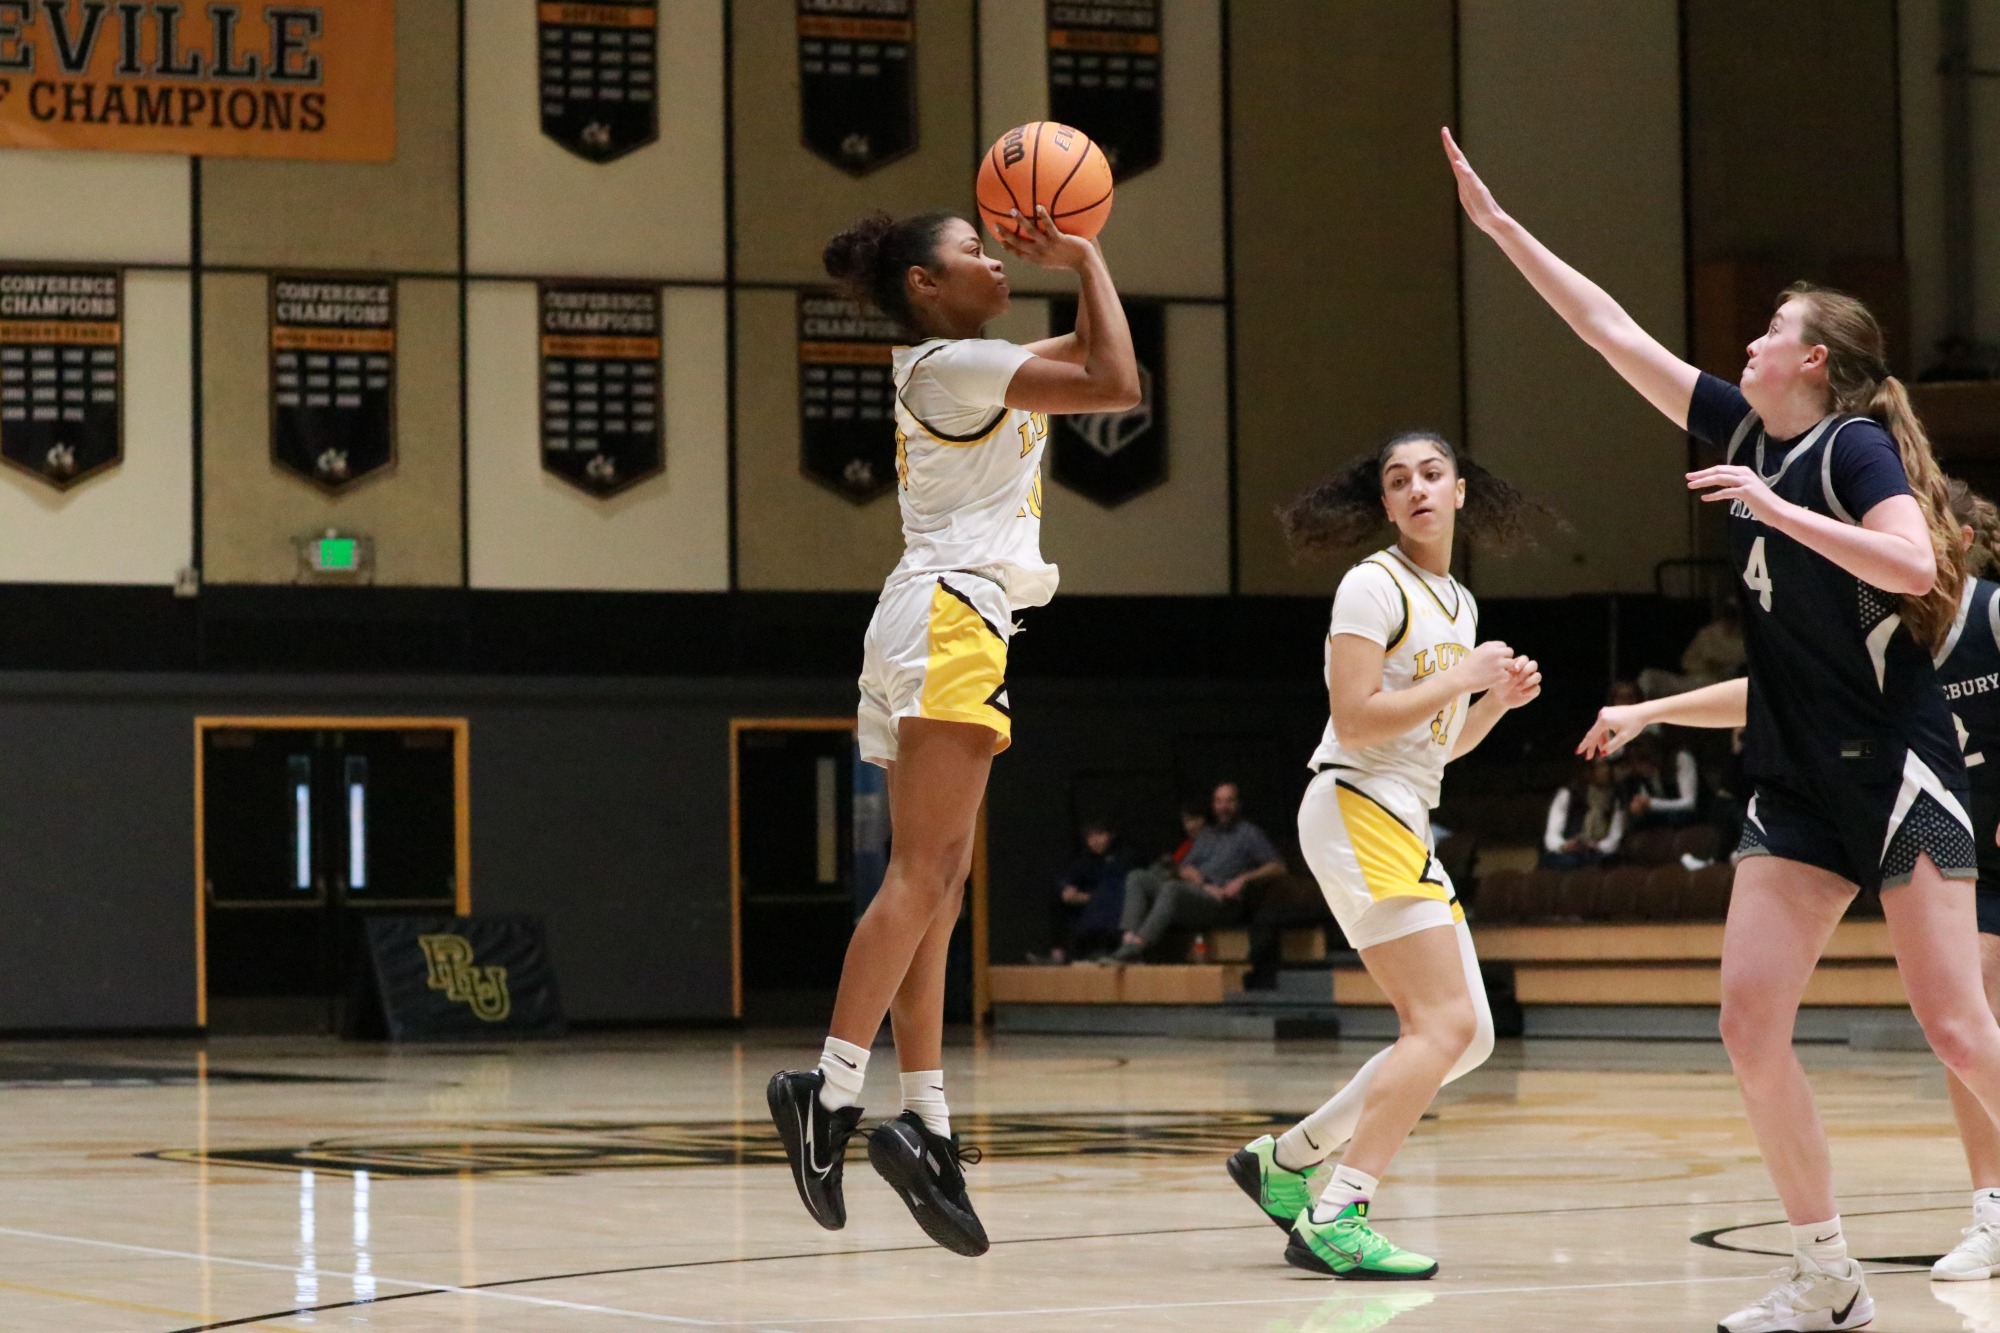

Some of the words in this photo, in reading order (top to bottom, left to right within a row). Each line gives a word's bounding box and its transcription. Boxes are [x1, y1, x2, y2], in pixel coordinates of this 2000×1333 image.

[29, 80, 326, 132] CHAMPIONS
[0, 275, 116, 295] CONFERENCE
[276, 282, 389, 303] CONFERENCE
[0, 295, 116, 317] CHAMPIONS
[277, 302, 389, 324] CHAMPIONS
[1742, 536, 1773, 613] 4
[1412, 643, 1471, 681] LUT
[418, 933, 511, 1021] PLU
